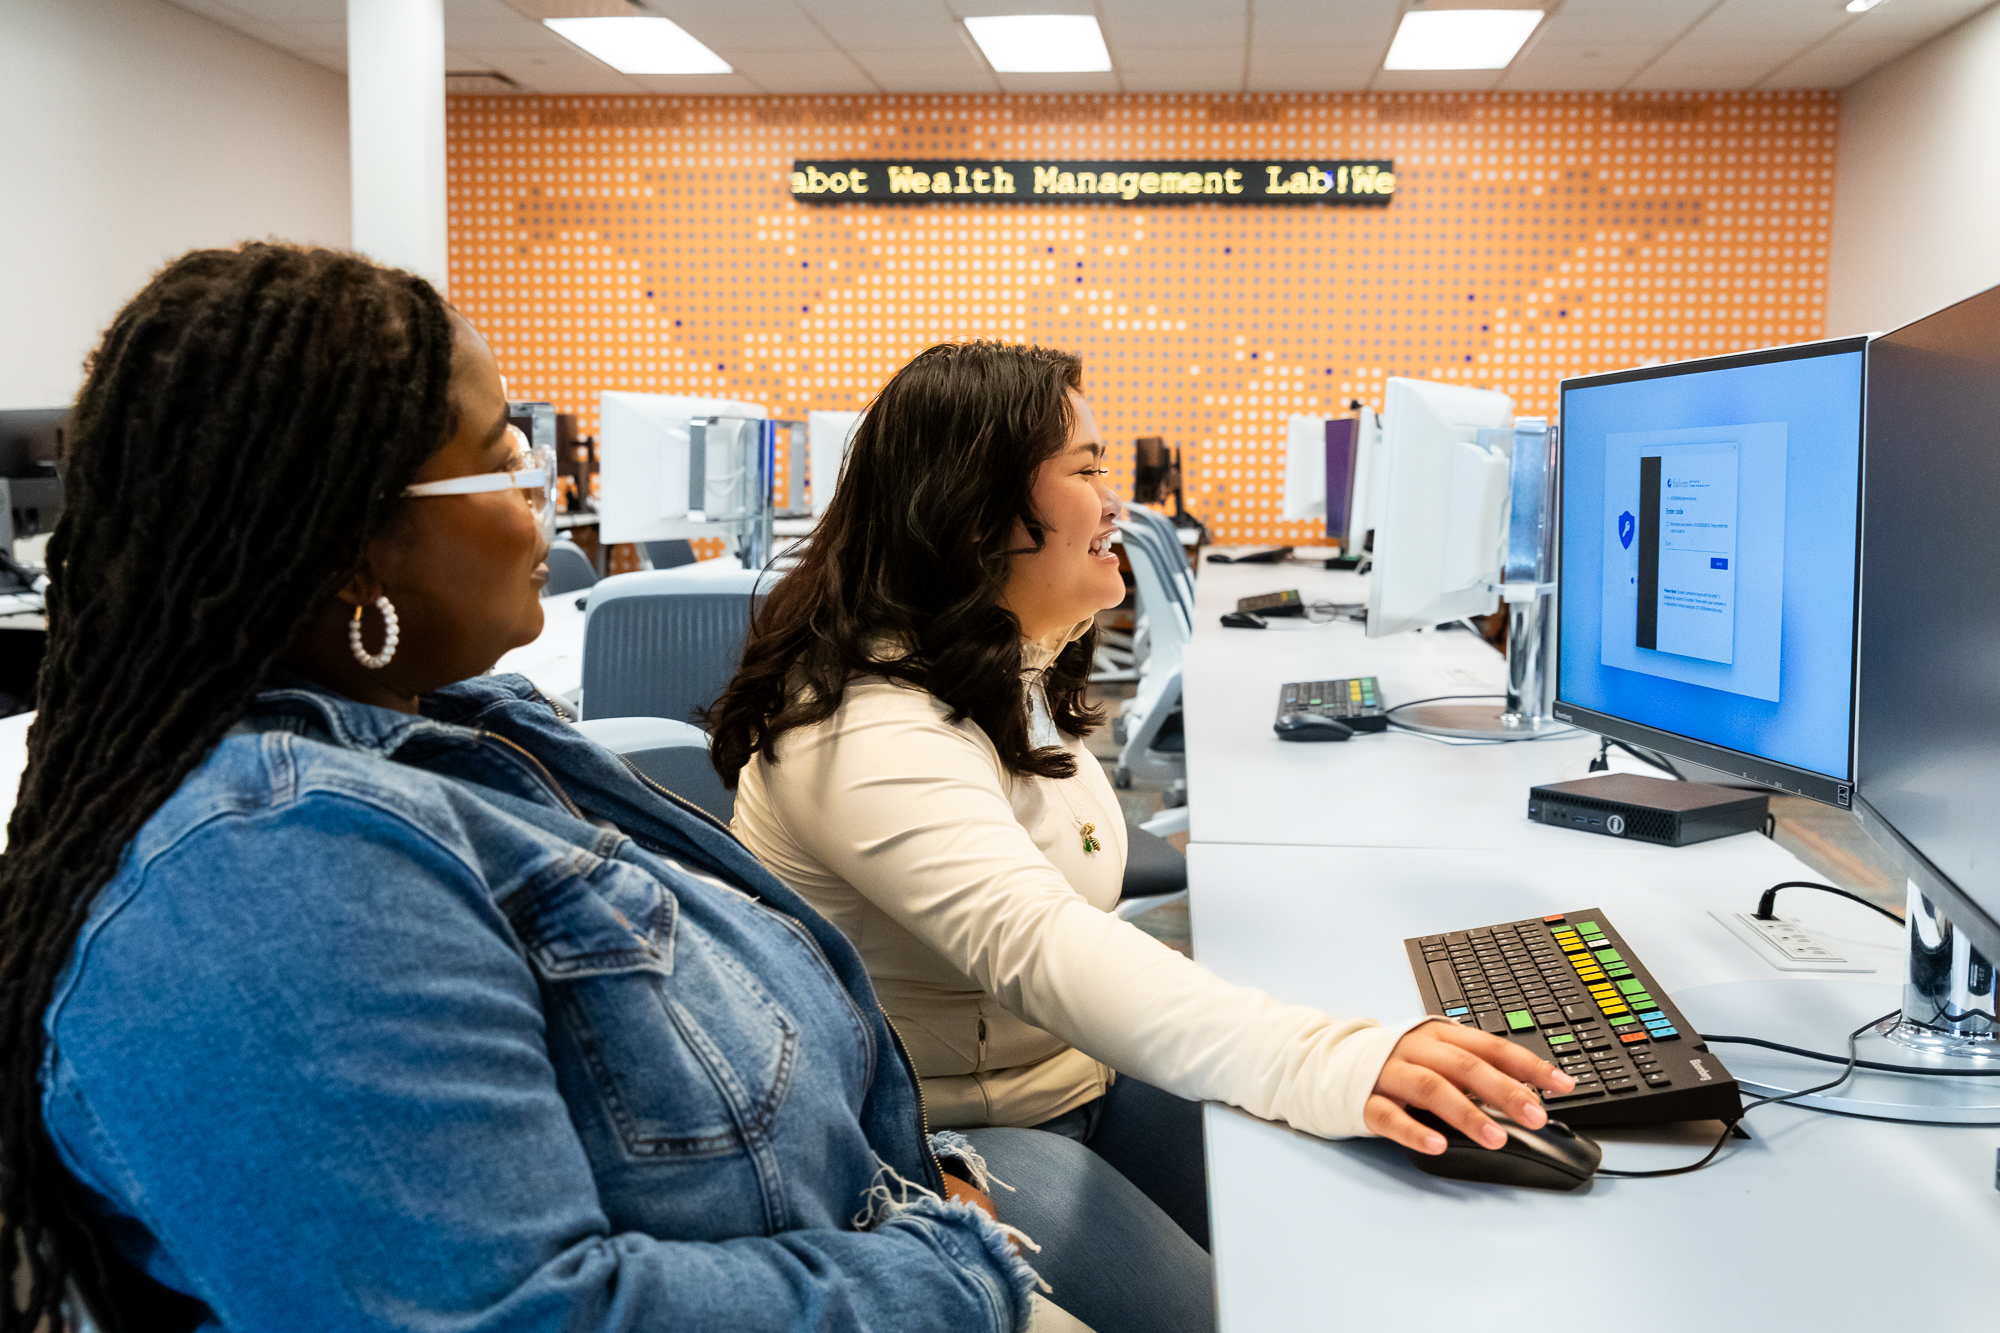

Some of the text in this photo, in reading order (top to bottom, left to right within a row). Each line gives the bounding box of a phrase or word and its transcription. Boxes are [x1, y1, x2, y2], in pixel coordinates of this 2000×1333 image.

[791, 166, 869, 194] abot
[887, 166, 1016, 194] Wealth
[1033, 166, 1243, 200] Management
